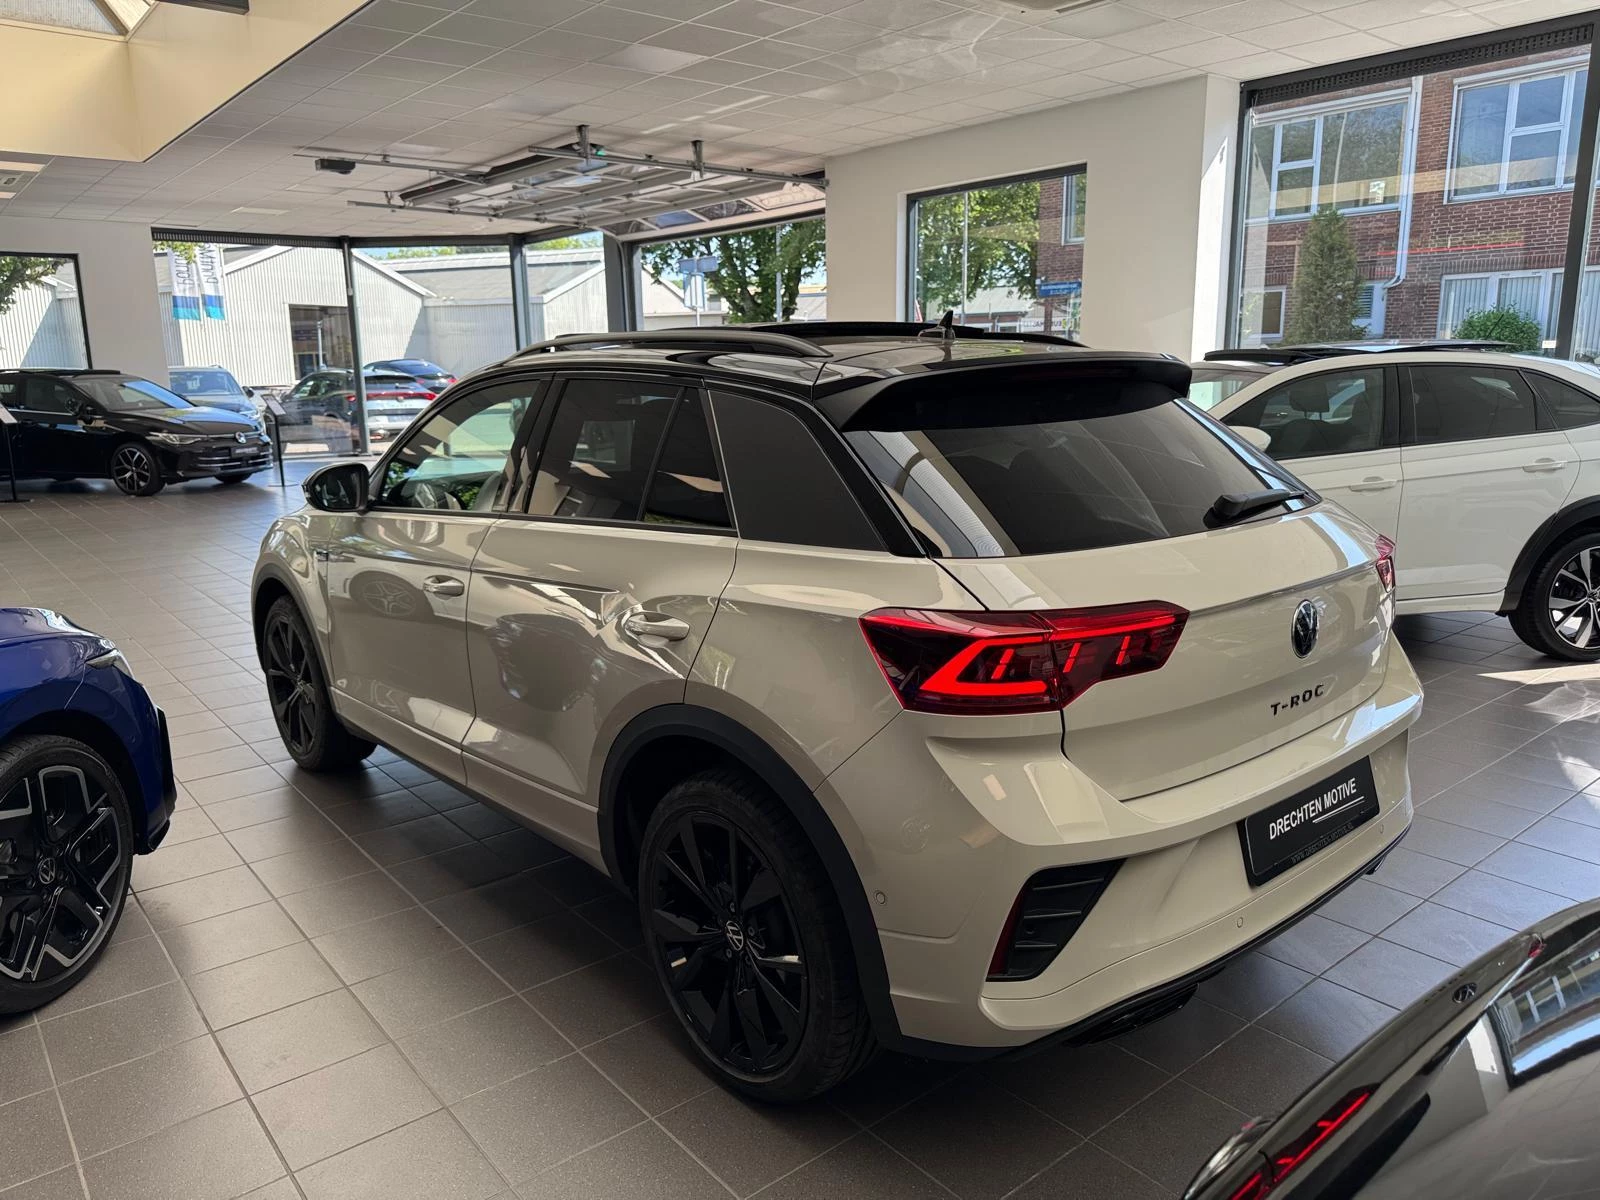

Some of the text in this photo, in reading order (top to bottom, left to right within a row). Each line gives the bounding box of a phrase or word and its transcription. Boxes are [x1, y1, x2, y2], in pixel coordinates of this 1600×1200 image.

[1271, 684, 1325, 716] T-ROC
[1269, 778, 1357, 840] DRECHTEN MOTIVE
